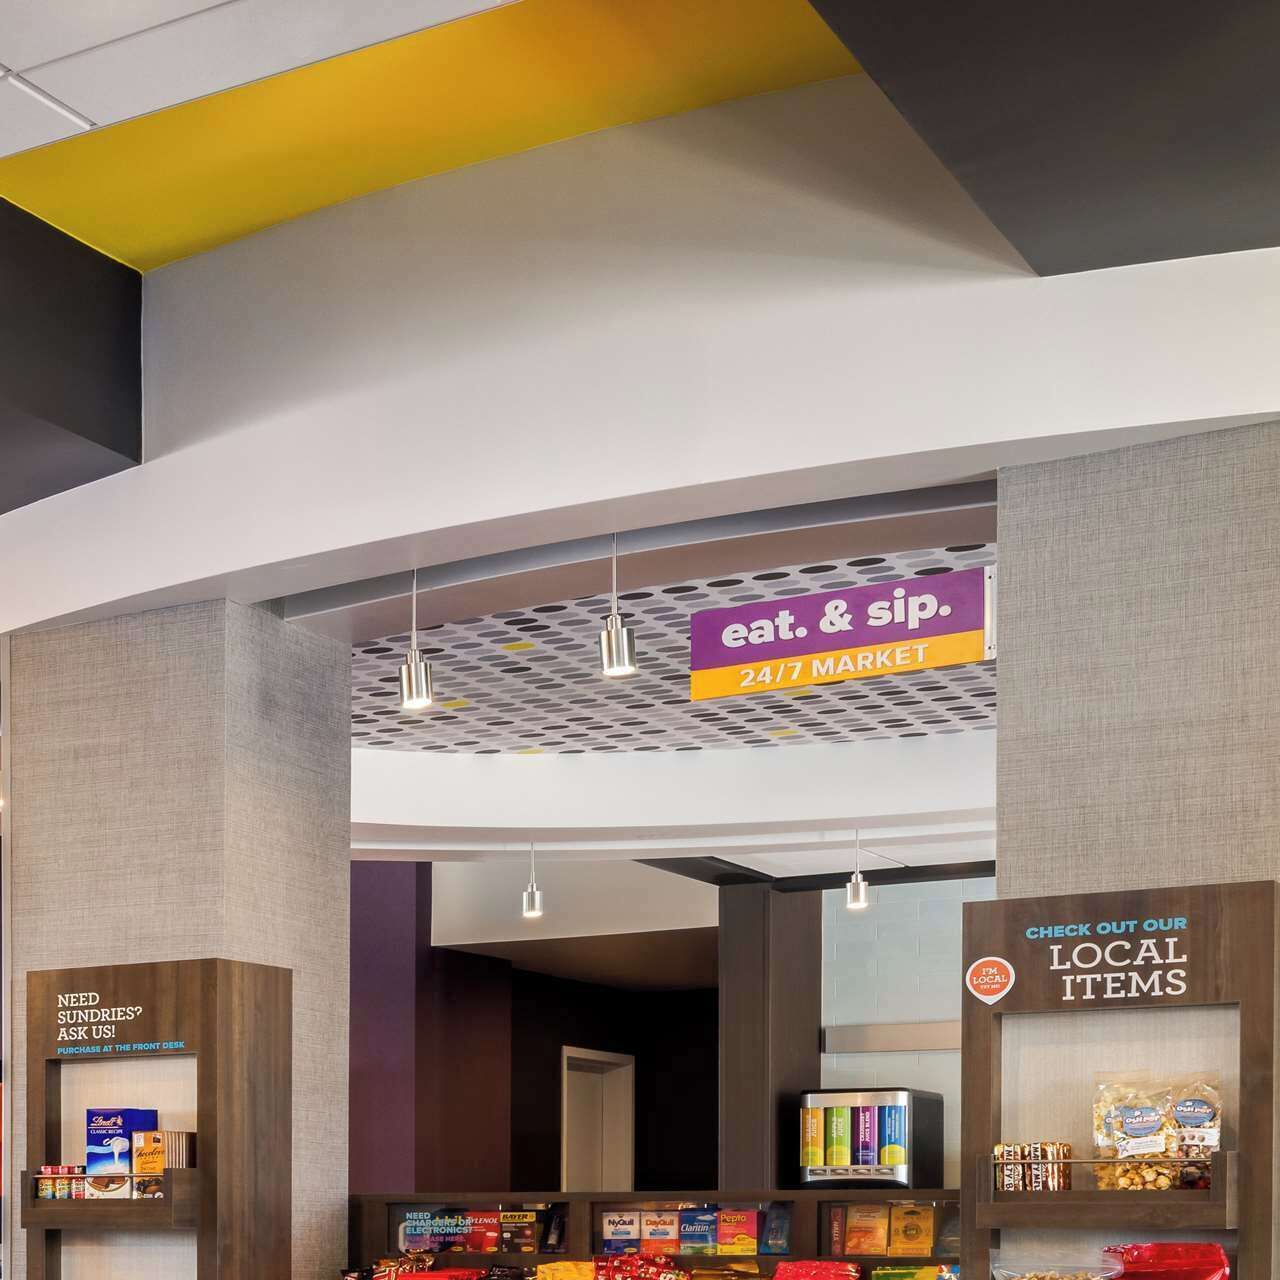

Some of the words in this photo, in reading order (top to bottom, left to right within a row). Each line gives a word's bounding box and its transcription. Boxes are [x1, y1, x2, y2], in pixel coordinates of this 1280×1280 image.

[721, 609, 808, 649] eat.
[819, 599, 855, 634] &
[866, 587, 953, 631] sip.
[739, 662, 802, 688] 24/7
[812, 642, 930, 678] MARKET
[1025, 923, 1091, 940] CHECK
[1096, 919, 1138, 935] OUT
[1143, 916, 1188, 932] OUR
[1049, 937, 1188, 970] LOCAL
[973, 974, 1008, 985] LOCAL
[1062, 969, 1188, 1001] ITEMS
[57, 992, 100, 1008] NEED
[57, 1006, 143, 1024] SUNDRIES?
[57, 1026, 89, 1041] ASK
[92, 1025, 116, 1039] US!
[57, 1045, 101, 1055] PURCHASE
[103, 1045, 113, 1053] AT
[115, 1044, 131, 1052] THE
[132, 1042, 161, 1051] FRONT
[162, 1041, 185, 1049] DESK
[90, 1115, 119, 1127] Lindt
[406, 1212, 431, 1220] NEED
[467, 1216, 499, 1224] TYLENOL
[608, 1218, 634, 1227] NyQuil
[645, 1218, 674, 1227] DayQuil
[720, 1214, 747, 1223] Pepto
[459, 1219, 472, 1227] OR
[680, 1223, 709, 1232] Claritin
